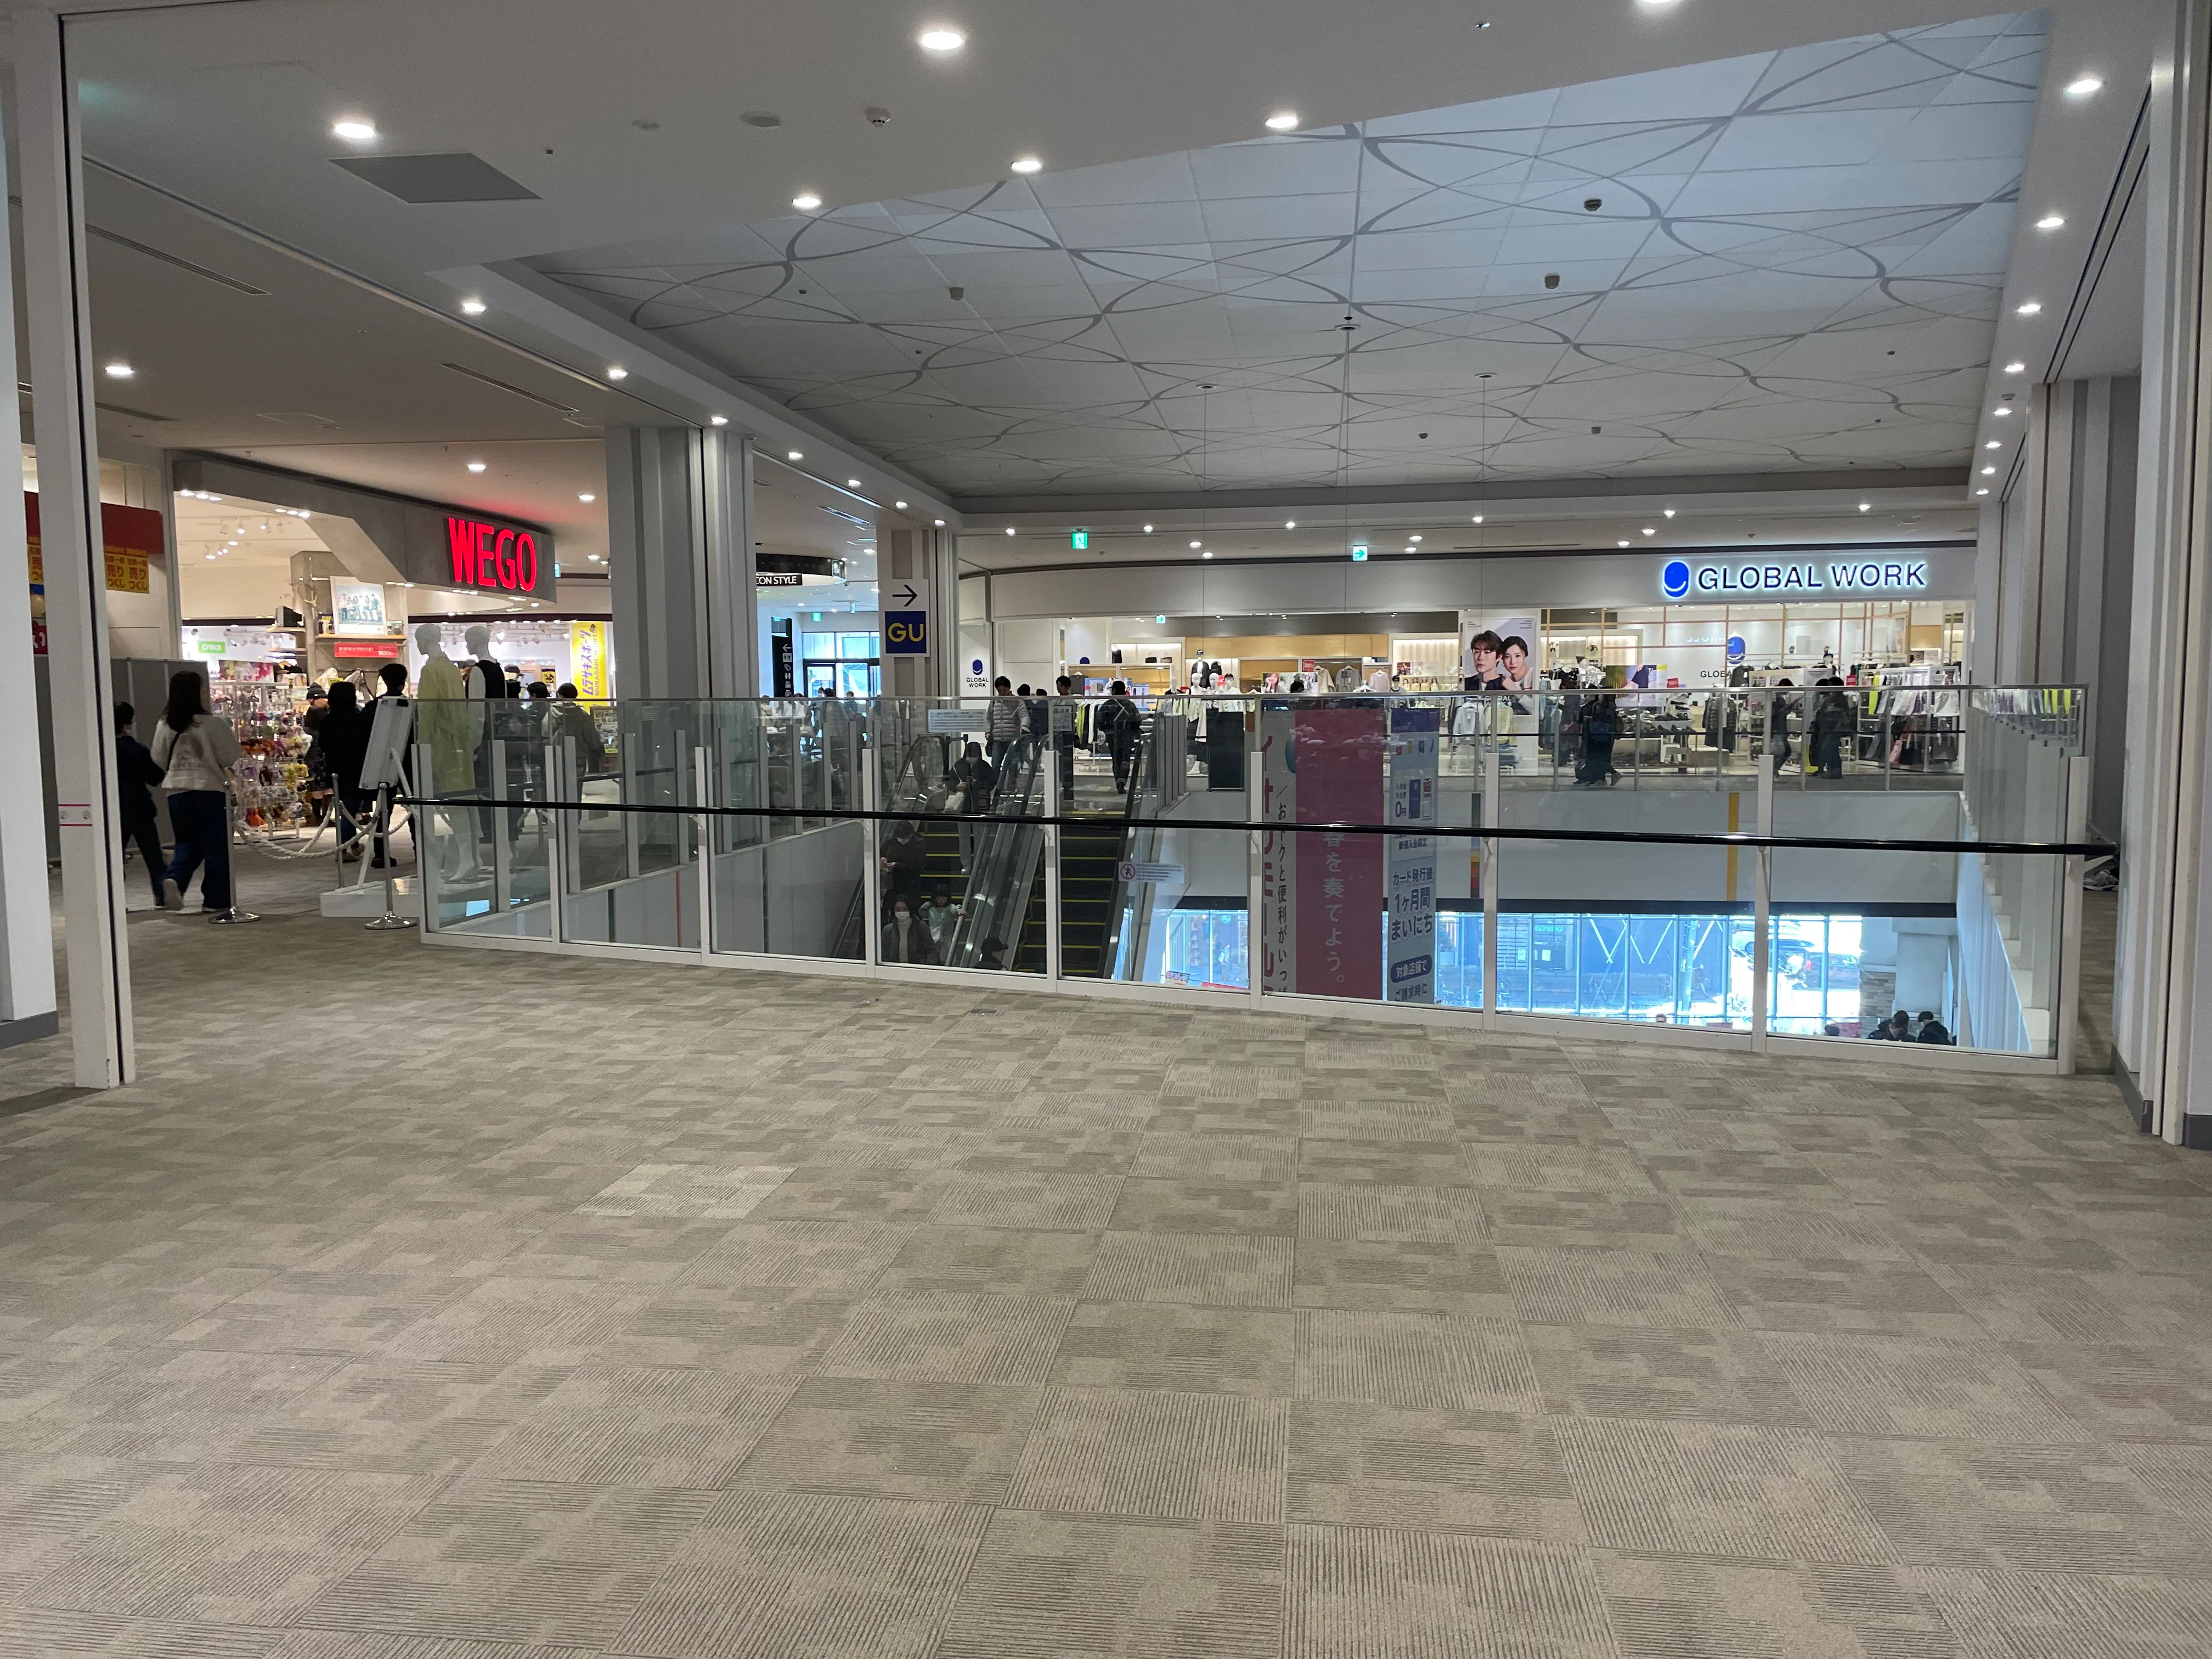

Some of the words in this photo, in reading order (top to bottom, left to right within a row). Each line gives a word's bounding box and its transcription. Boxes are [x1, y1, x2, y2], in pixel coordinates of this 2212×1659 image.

[448, 517, 537, 592] WEGO
[774, 576, 797, 585] STYLE
[1698, 566, 1823, 590] GLOBAL
[1831, 562, 1927, 587] WORK
[888, 623, 924, 642] GU
[579, 629, 594, 696] ムラサキスポーツ
[1395, 801, 1407, 817] 0円
[1392, 866, 1434, 887] カード発行後
[1391, 913, 1432, 941] まいにち
[1396, 960, 1427, 979] 対象店舗で
